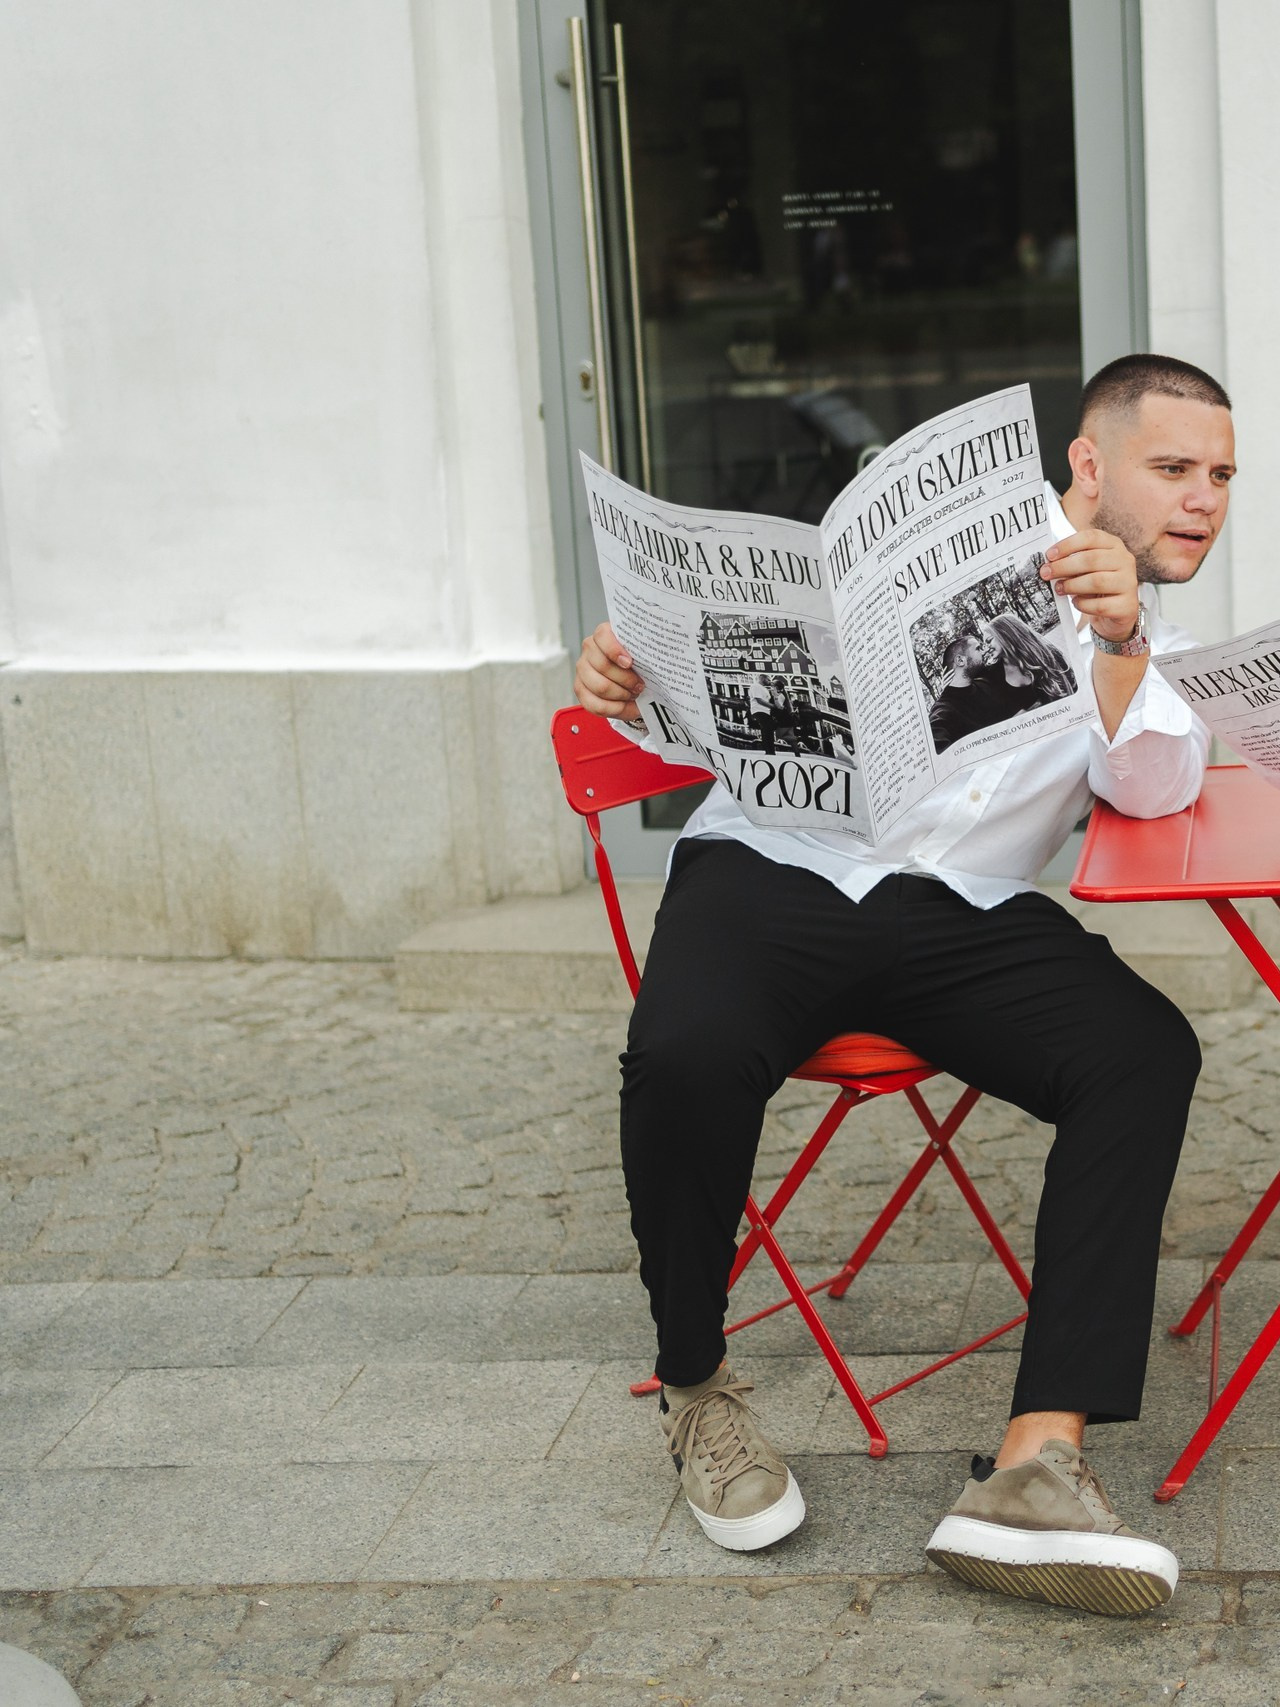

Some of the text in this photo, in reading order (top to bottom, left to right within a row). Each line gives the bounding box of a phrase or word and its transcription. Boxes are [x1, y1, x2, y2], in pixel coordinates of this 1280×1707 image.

[592, 491, 822, 591] ALEXANDRA & RADU
[827, 418, 1033, 590] THE LOVE GAZETTE
[846, 572, 863, 594] 15/05
[1002, 471, 1025, 486] 2027
[893, 493, 1047, 603] SAVE THE DATE
[626, 548, 780, 606] MRS. & MR. GAVRIL
